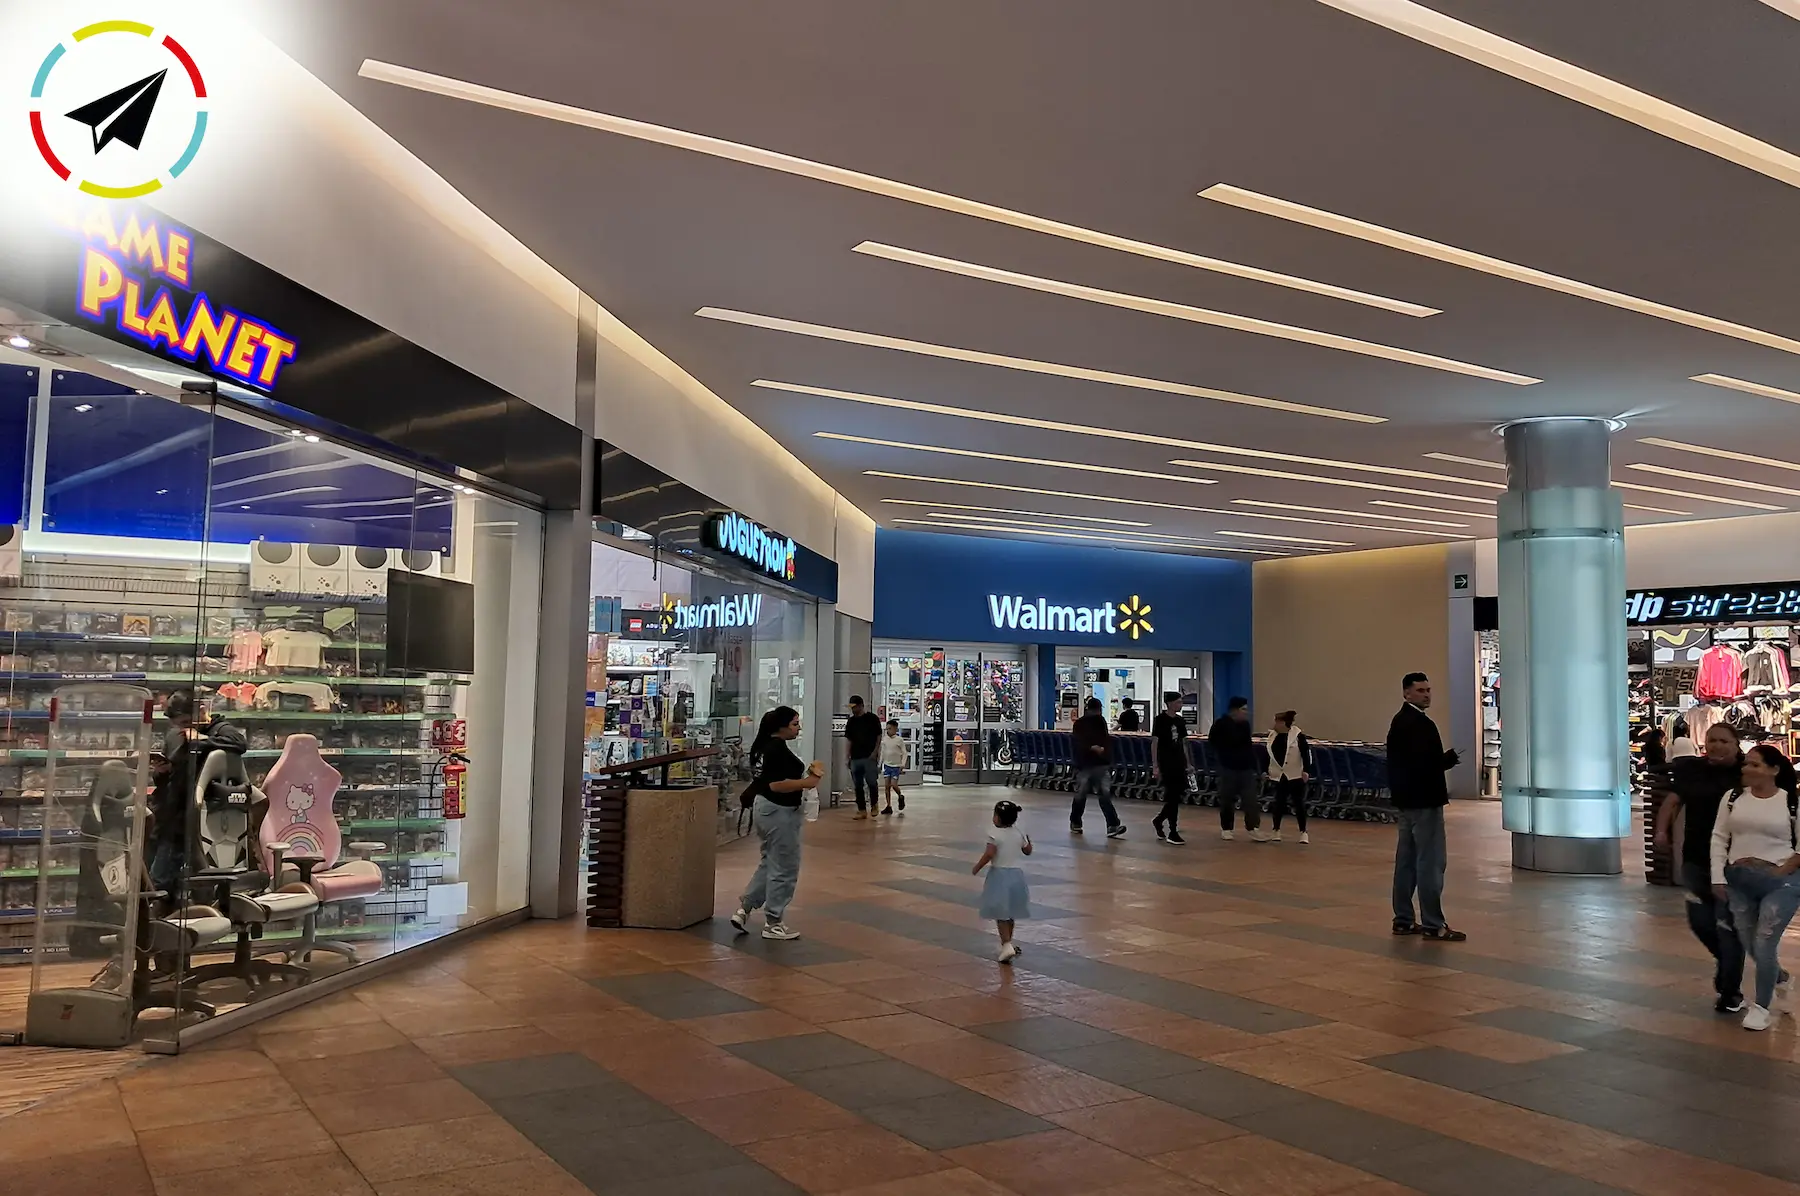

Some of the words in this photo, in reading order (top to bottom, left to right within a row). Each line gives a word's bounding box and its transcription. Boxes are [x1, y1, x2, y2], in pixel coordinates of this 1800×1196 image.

[66, 201, 190, 285] AME
[81, 247, 297, 386] PLANET
[718, 511, 787, 578] JUGUETRON
[986, 594, 1117, 634] Walmart
